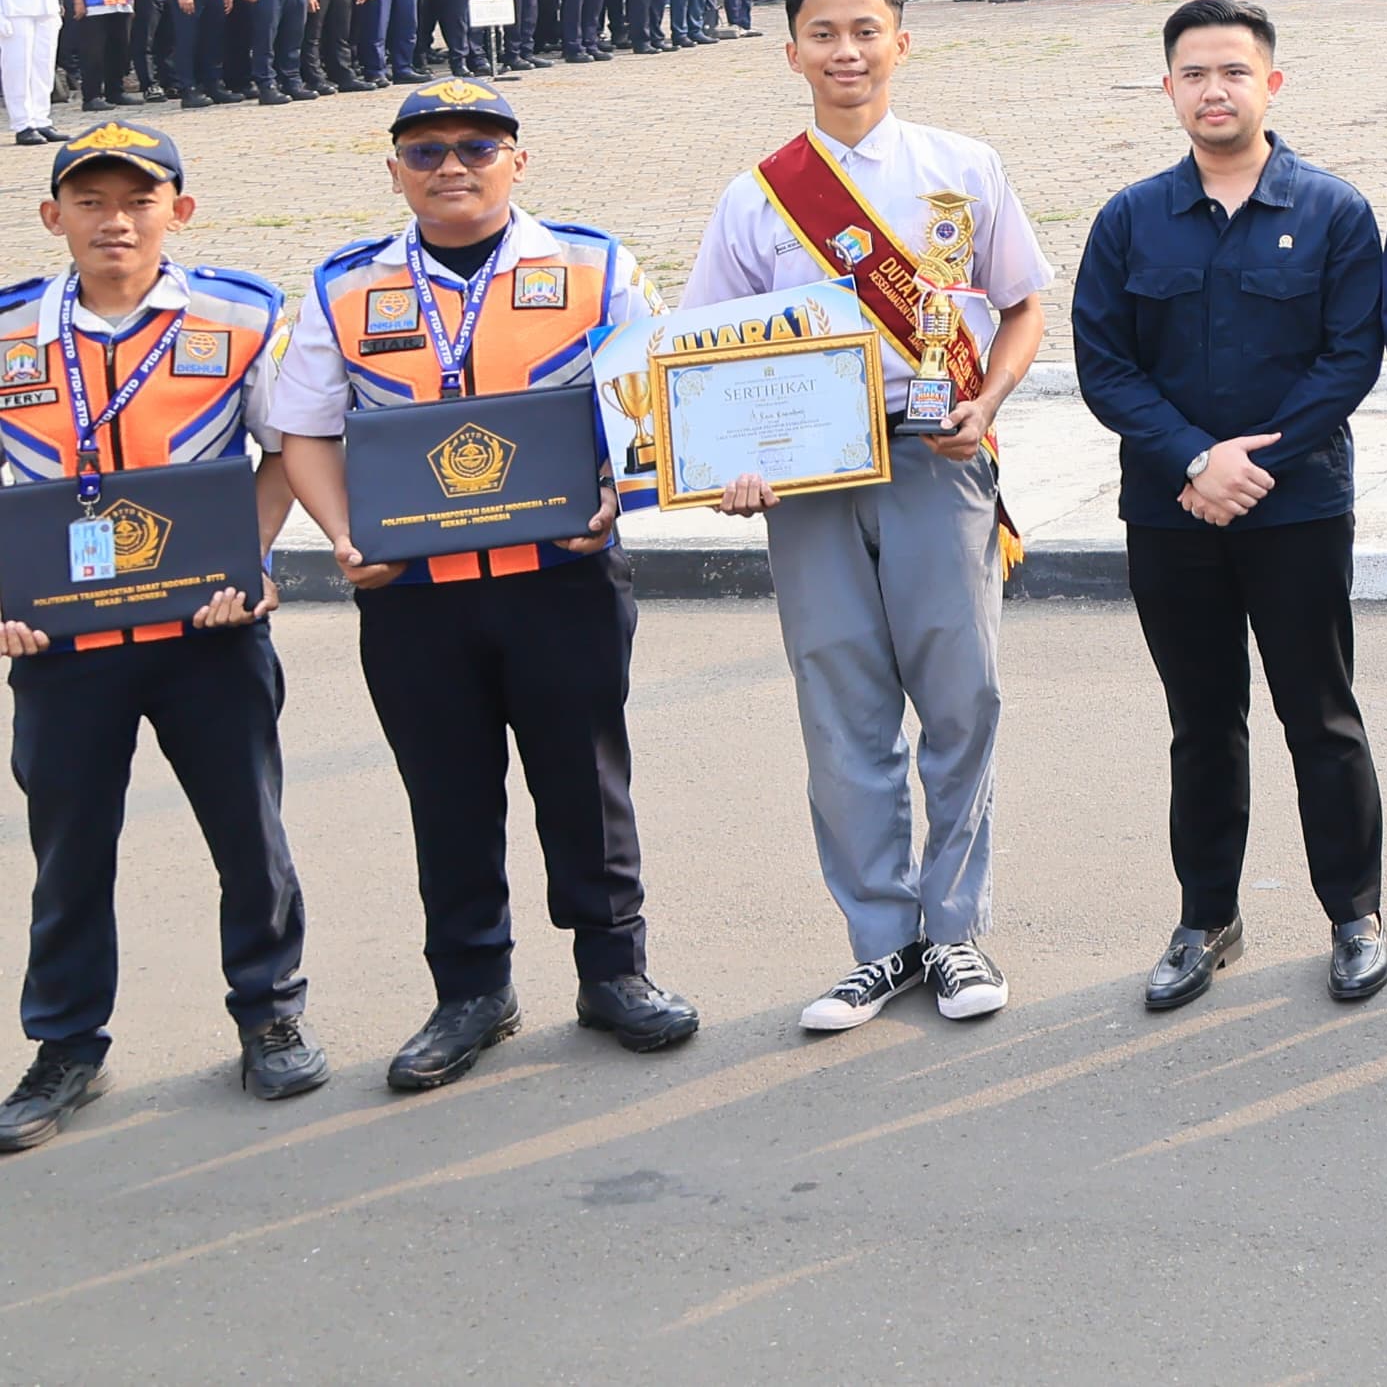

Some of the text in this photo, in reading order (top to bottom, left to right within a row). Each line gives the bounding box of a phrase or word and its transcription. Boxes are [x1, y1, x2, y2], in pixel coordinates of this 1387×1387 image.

[878, 257, 918, 300] DUTA
[176, 363, 223, 374] DISHUB
[4, 391, 44, 406] FERY
[724, 378, 817, 402] SERTIFIKAT
[382, 514, 425, 527] POLITEKNIK
[426, 507, 480, 521] TRANSPORTASI
[480, 504, 504, 515] DARAT
[504, 499, 543, 511] INDONESIA
[440, 512, 511, 529] BEKASI INDONESIA
[33, 593, 79, 607] POLITEKNIK
[80, 586, 135, 600] TRANSPORTASI
[136, 582, 160, 593] DARAT
[161, 576, 201, 589] INDONESIA
[94, 590, 168, 608] BEKASI INDONESIA
